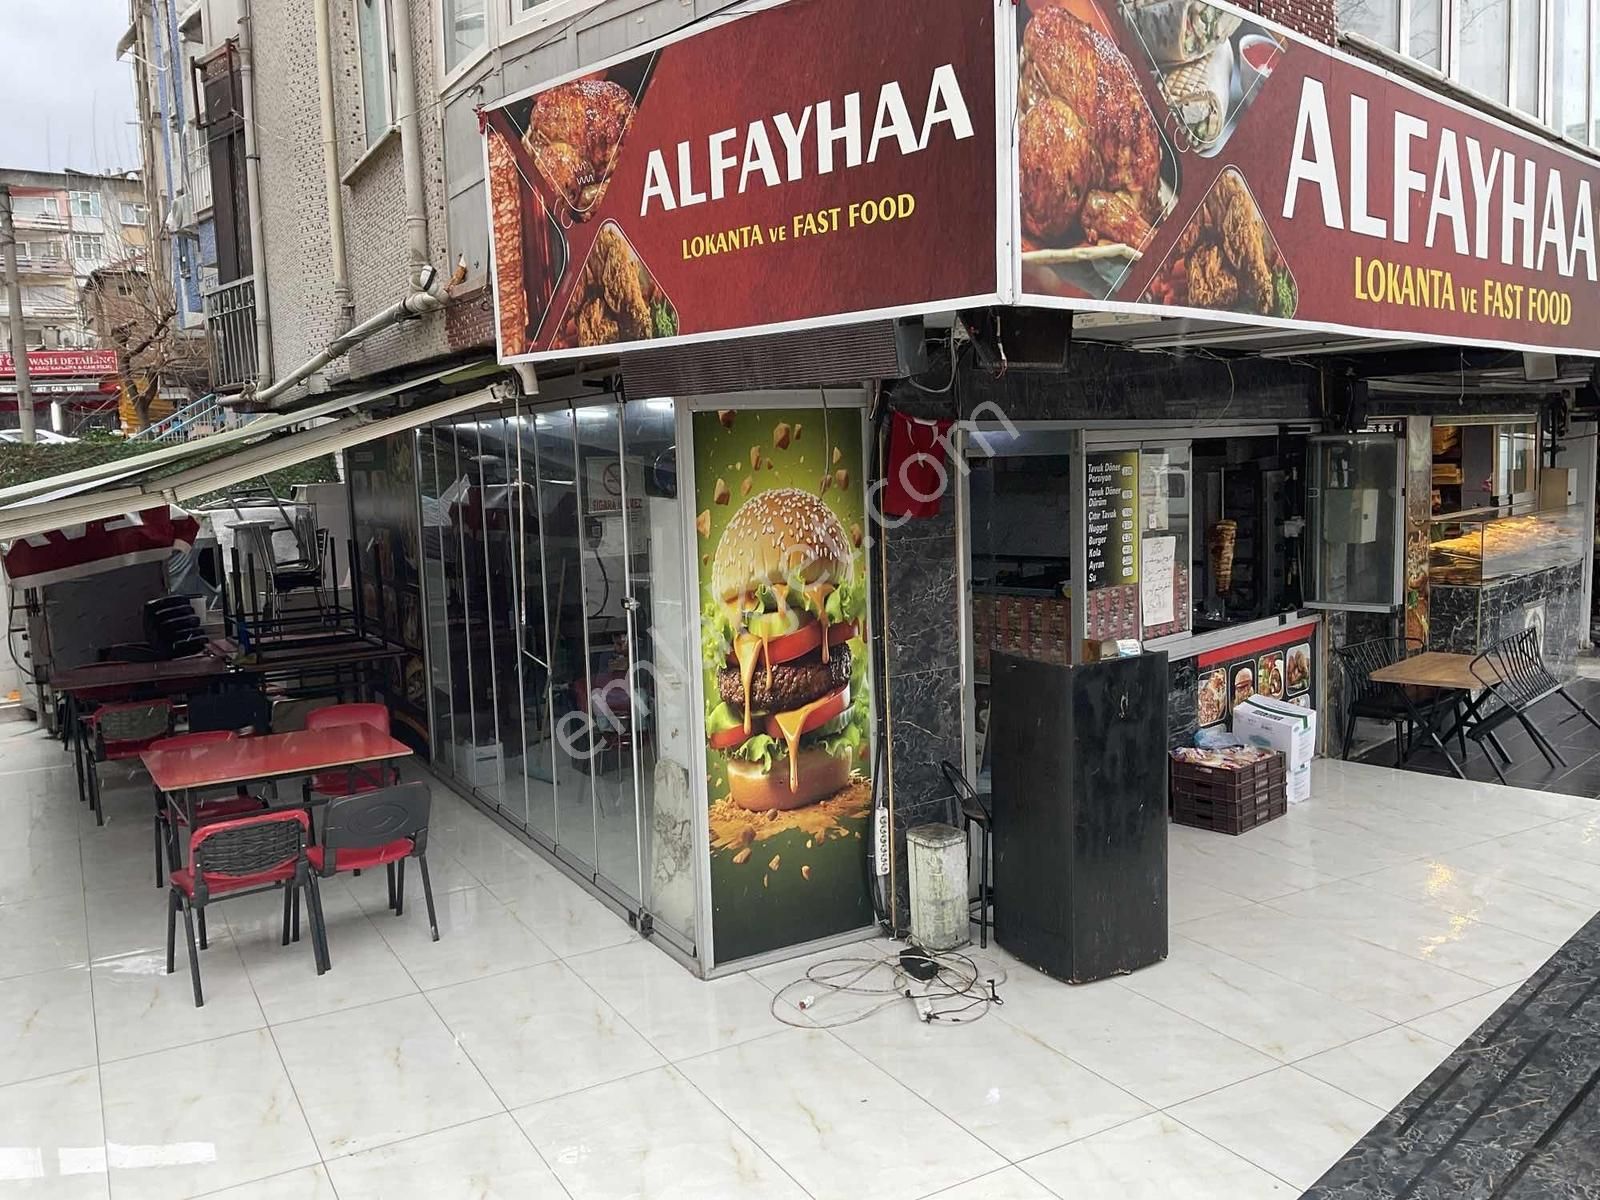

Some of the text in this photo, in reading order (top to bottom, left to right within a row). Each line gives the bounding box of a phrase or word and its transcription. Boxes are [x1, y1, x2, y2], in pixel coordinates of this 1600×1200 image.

[640, 63, 975, 217] ALFAYHAA
[1282, 76, 1598, 282] ALFAYHAA
[682, 224, 764, 260] LOKANTA
[793, 207, 841, 239] FAST
[848, 193, 916, 228] FOOD
[1354, 256, 1456, 310] LOKANTA
[1484, 279, 1524, 318] FAST
[1527, 287, 1572, 327] FOOD
[29, 357, 58, 366] WASH
[1088, 487, 1104, 497] Tavuk
[1105, 486, 1121, 496] Döner
[1088, 497, 1107, 507] Dürüm
[1102, 509, 1117, 519] Tavuk
[1088, 523, 1108, 534] Nugget
[1088, 536, 1107, 546] Burger
[1088, 548, 1102, 558] Kola
[1088, 560, 1105, 571] Ayran
[1088, 573, 1097, 583] Su
